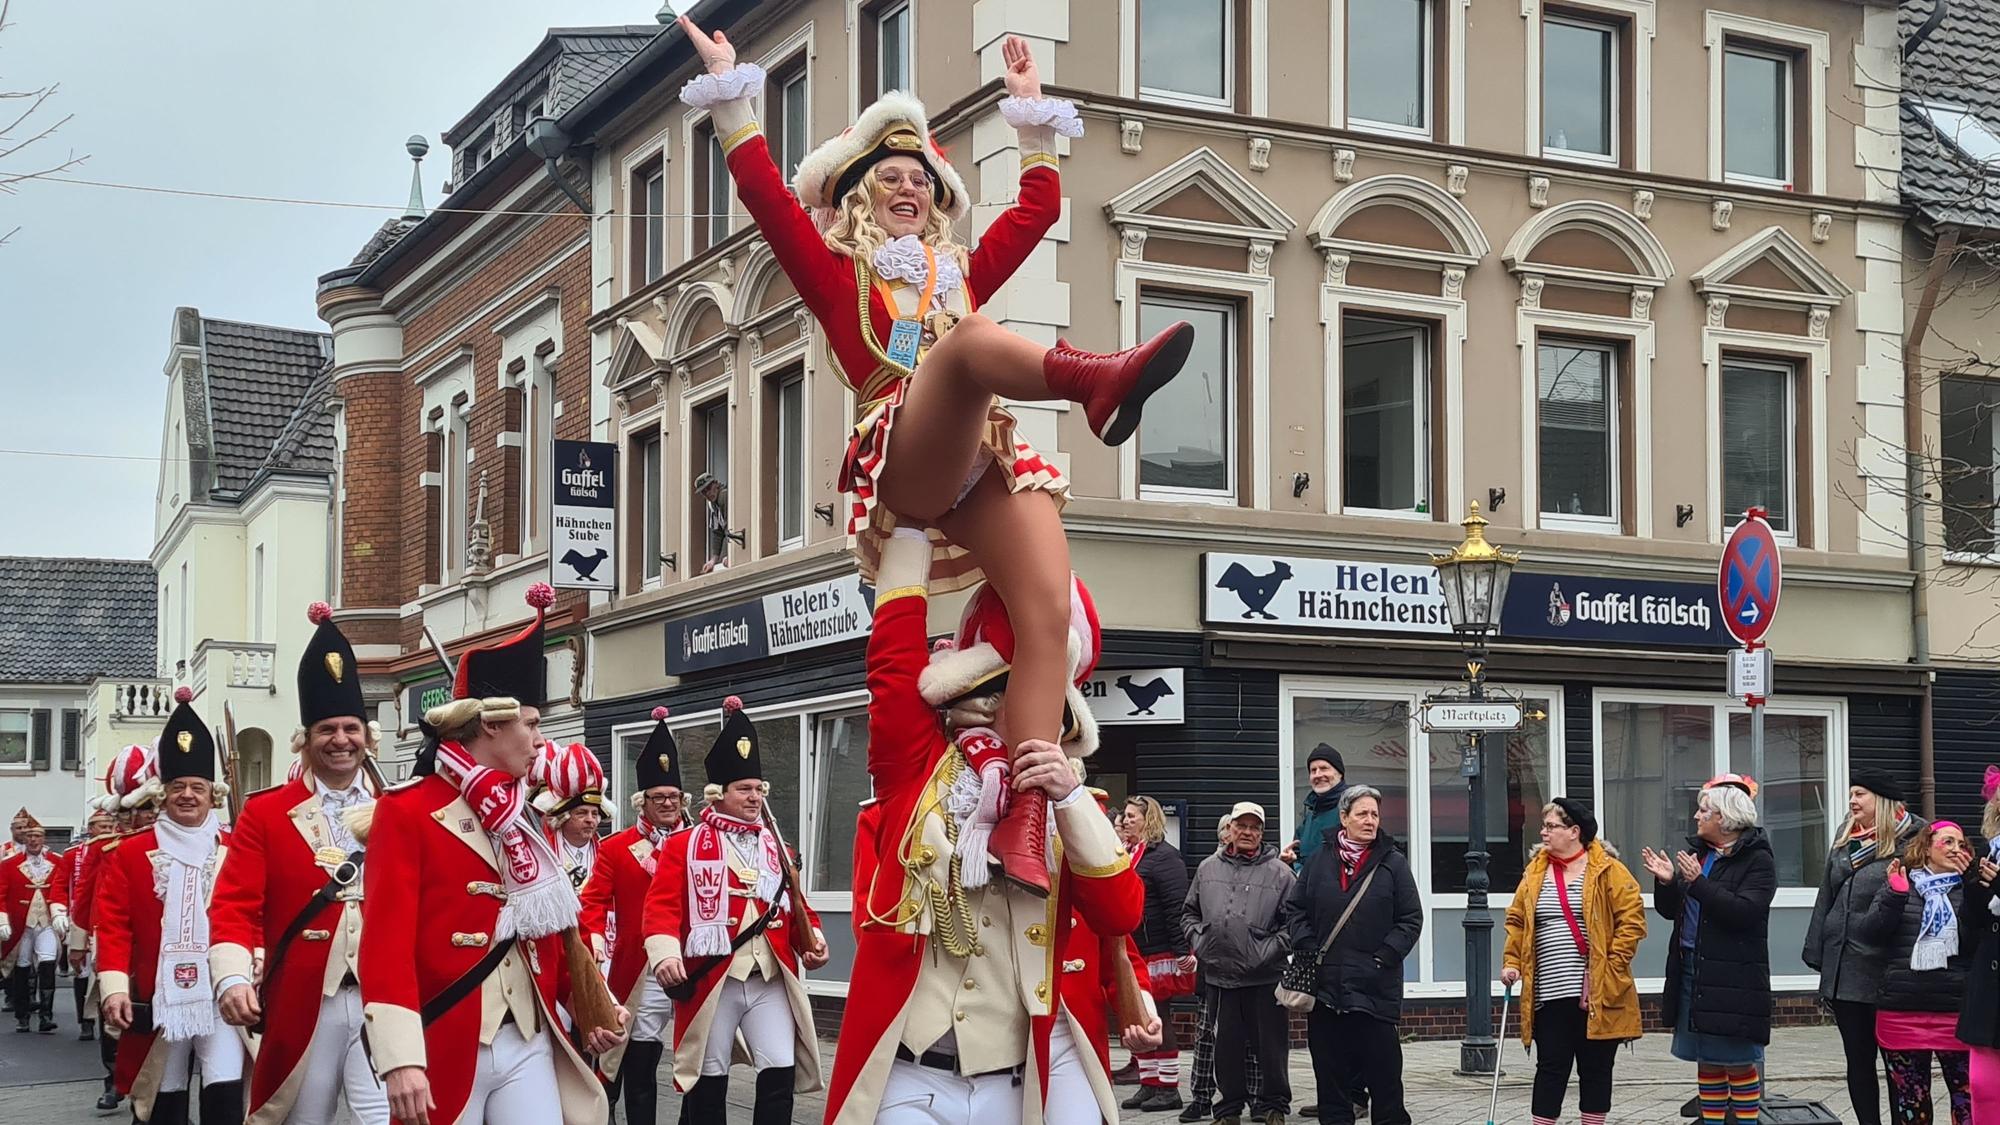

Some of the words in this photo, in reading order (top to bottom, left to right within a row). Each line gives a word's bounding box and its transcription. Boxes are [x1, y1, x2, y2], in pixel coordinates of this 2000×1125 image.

[561, 468, 606, 489] Gaffel
[570, 487, 598, 499] Kölsch
[556, 516, 612, 531] Hähnchen
[568, 529, 600, 541] Stube
[783, 584, 841, 618] Helen's
[1298, 590, 1448, 625] Hähnchenst
[1575, 591, 1636, 625] Gaffel
[1640, 595, 1711, 631] Kölsch
[692, 625, 720, 654] Gaffel
[719, 618, 749, 650] Kölsch
[769, 609, 859, 649] Hähnchenstube
[1442, 709, 1506, 723] Marktplatz
[695, 867, 720, 887] BNZ
